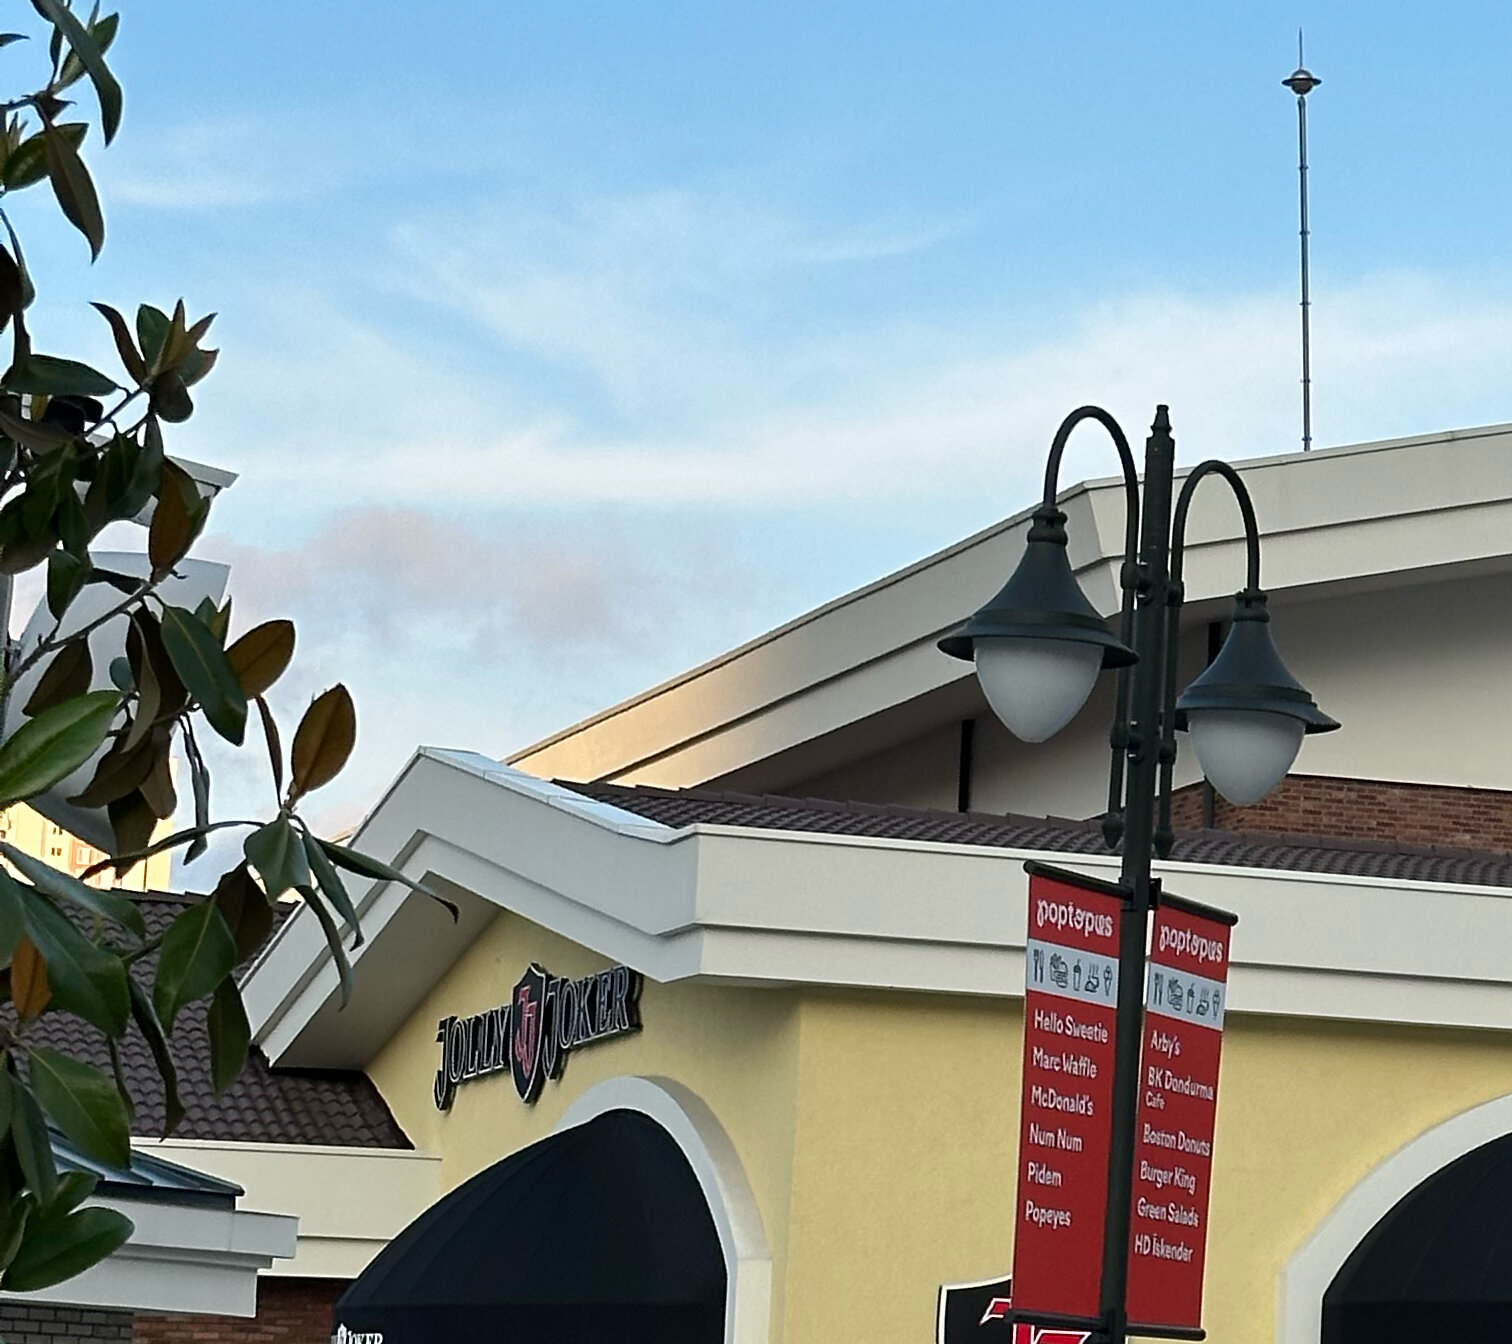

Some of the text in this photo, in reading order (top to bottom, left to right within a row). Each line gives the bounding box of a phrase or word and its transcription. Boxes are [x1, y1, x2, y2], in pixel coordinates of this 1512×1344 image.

[434, 1005, 512, 1110] JOLLY
[542, 965, 629, 1079] JOKER
[1034, 1009, 1109, 1043] Hello Sweetie
[1033, 1046, 1097, 1079] Marc Waffle
[1148, 1066, 1214, 1100] BK Dondurma
[1031, 1085, 1094, 1115] McDonald's
[1146, 1092, 1165, 1109] Cafe
[1029, 1123, 1082, 1152] Num Num
[1143, 1123, 1211, 1156] Boston Donuts
[1027, 1162, 1062, 1187] Pidem
[1140, 1160, 1196, 1195] Burger King
[1025, 1200, 1072, 1229] Popeyes
[1137, 1197, 1199, 1228] Green Salads
[1135, 1233, 1193, 1262] HD İskender
